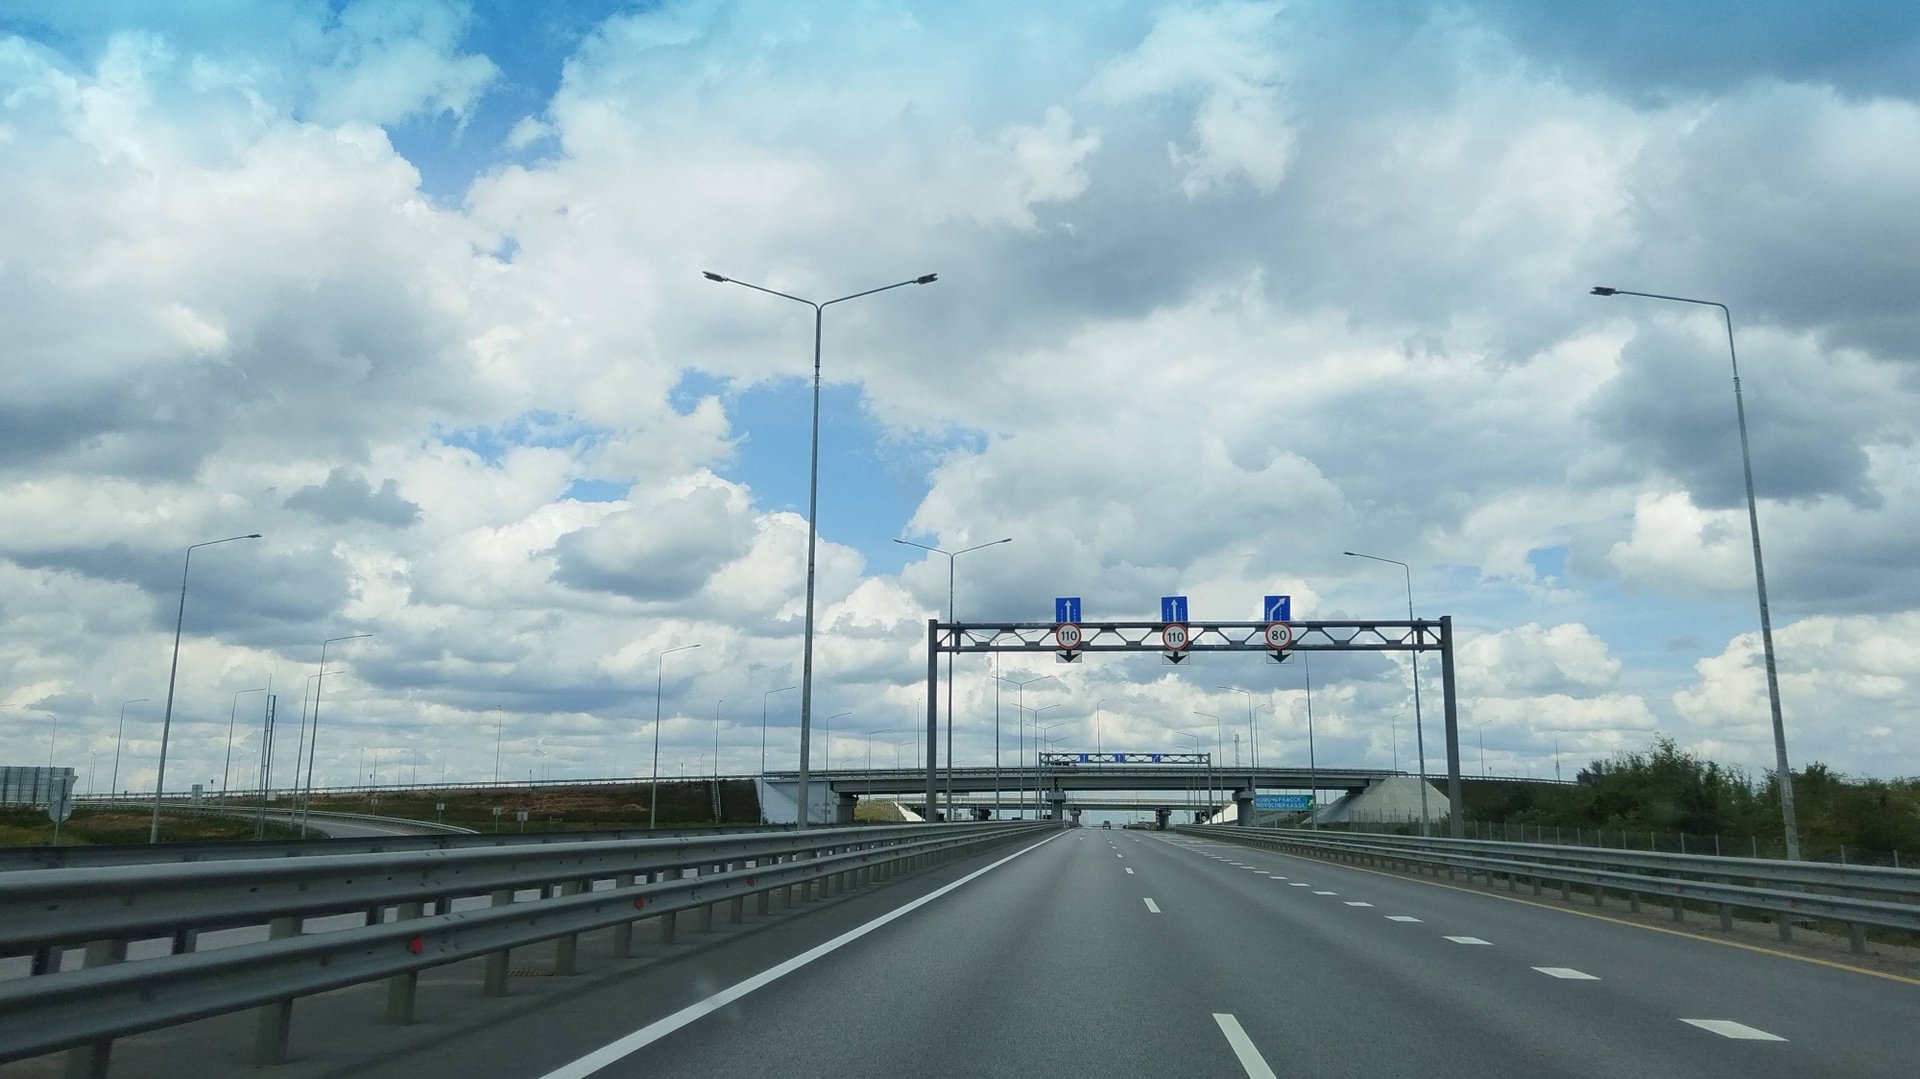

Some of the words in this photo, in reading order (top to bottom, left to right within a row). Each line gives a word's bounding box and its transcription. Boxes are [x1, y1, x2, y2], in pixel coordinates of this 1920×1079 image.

[1061, 630, 1077, 641] 110
[1167, 631, 1184, 642] 110
[1271, 630, 1287, 641] 80
